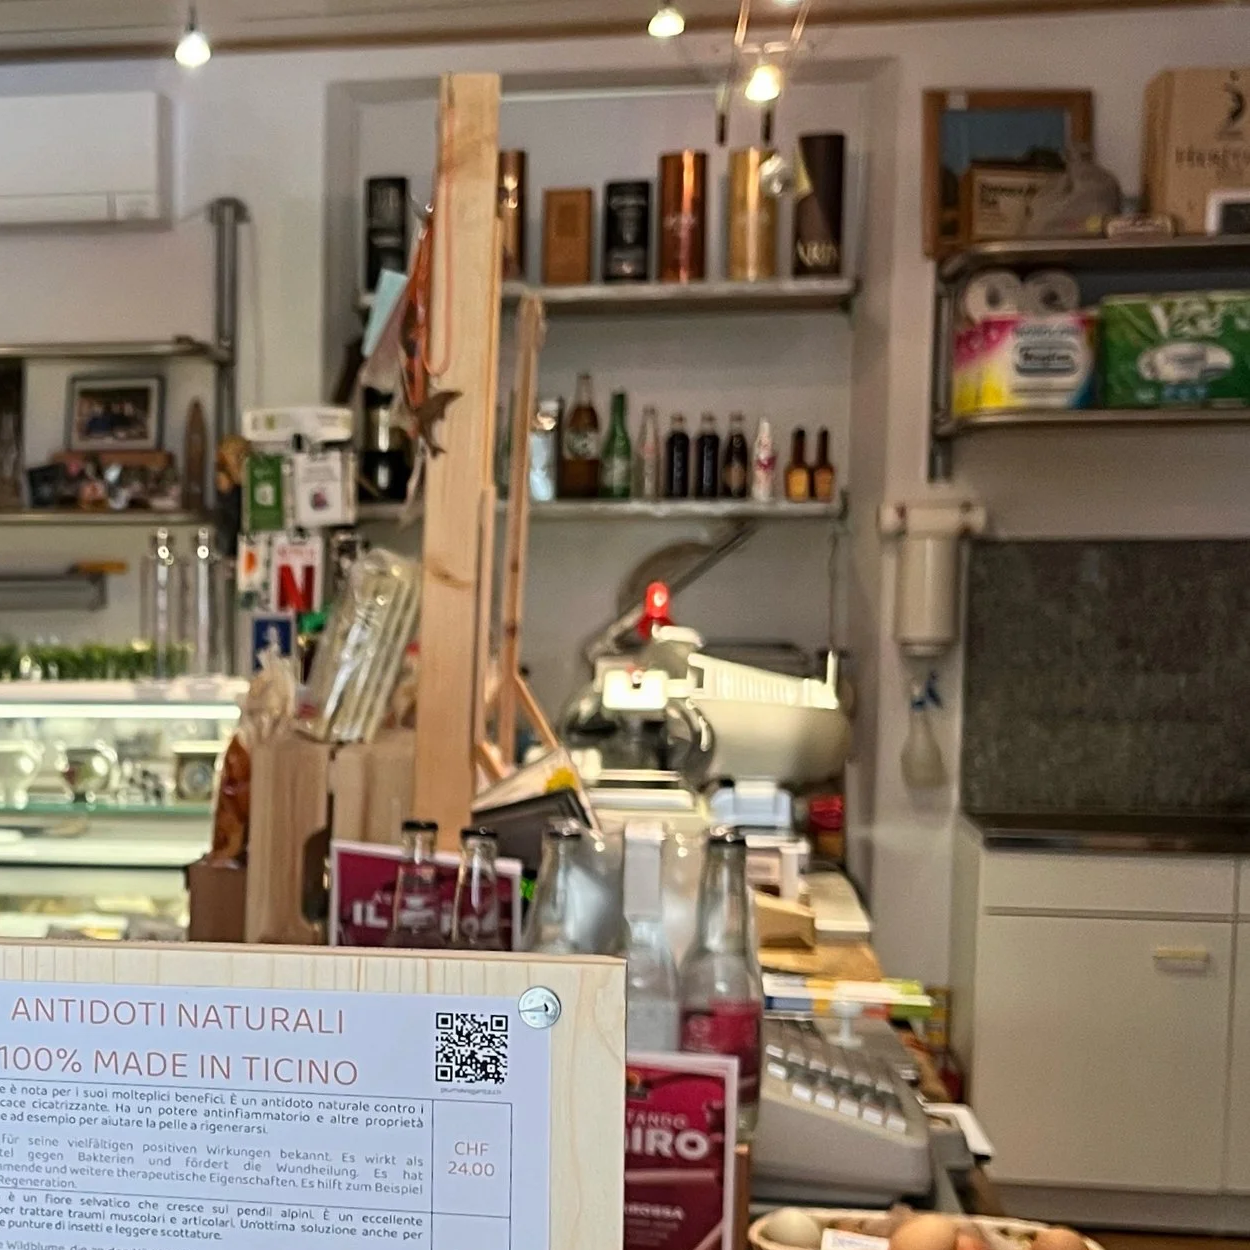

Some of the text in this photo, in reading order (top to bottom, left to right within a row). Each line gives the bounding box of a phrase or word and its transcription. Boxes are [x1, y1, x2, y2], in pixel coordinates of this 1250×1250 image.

[11, 997, 344, 1035] ANTIDOTI NATURALI
[94, 1050, 188, 1078] MADE
[200, 1054, 231, 1080] IN
[242, 1056, 359, 1086] TICINO
[20, 1086, 47, 1095] nota
[51, 1088, 71, 1098] per
[82, 1088, 108, 1098] suoi
[111, 1090, 170, 1102] molteplici
[241, 1097, 257, 1105] un
[260, 1097, 313, 1108] antidoto
[318, 1100, 370, 1110] naturale
[373, 1103, 415, 1113] contro
[9, 1111, 24, 1121] ad
[26, 1114, 77, 1125] esempio
[78, 1116, 99, 1126] per
[100, 1116, 143, 1127] aiutare
[145, 1118, 156, 1128] la
[158, 1119, 188, 1130] pelle
[115, 1103, 131, 1113] Ha
[137, 1106, 152, 1114] un
[157, 1106, 198, 1117] potere
[203, 1108, 310, 1121] antinfiammatorio
[329, 1113, 359, 1124] altre
[365, 1116, 424, 1128] proprietà
[454, 1141, 490, 1157] CHF
[625, 1127, 710, 1161] IRO
[447, 1161, 496, 1178] 24.00
